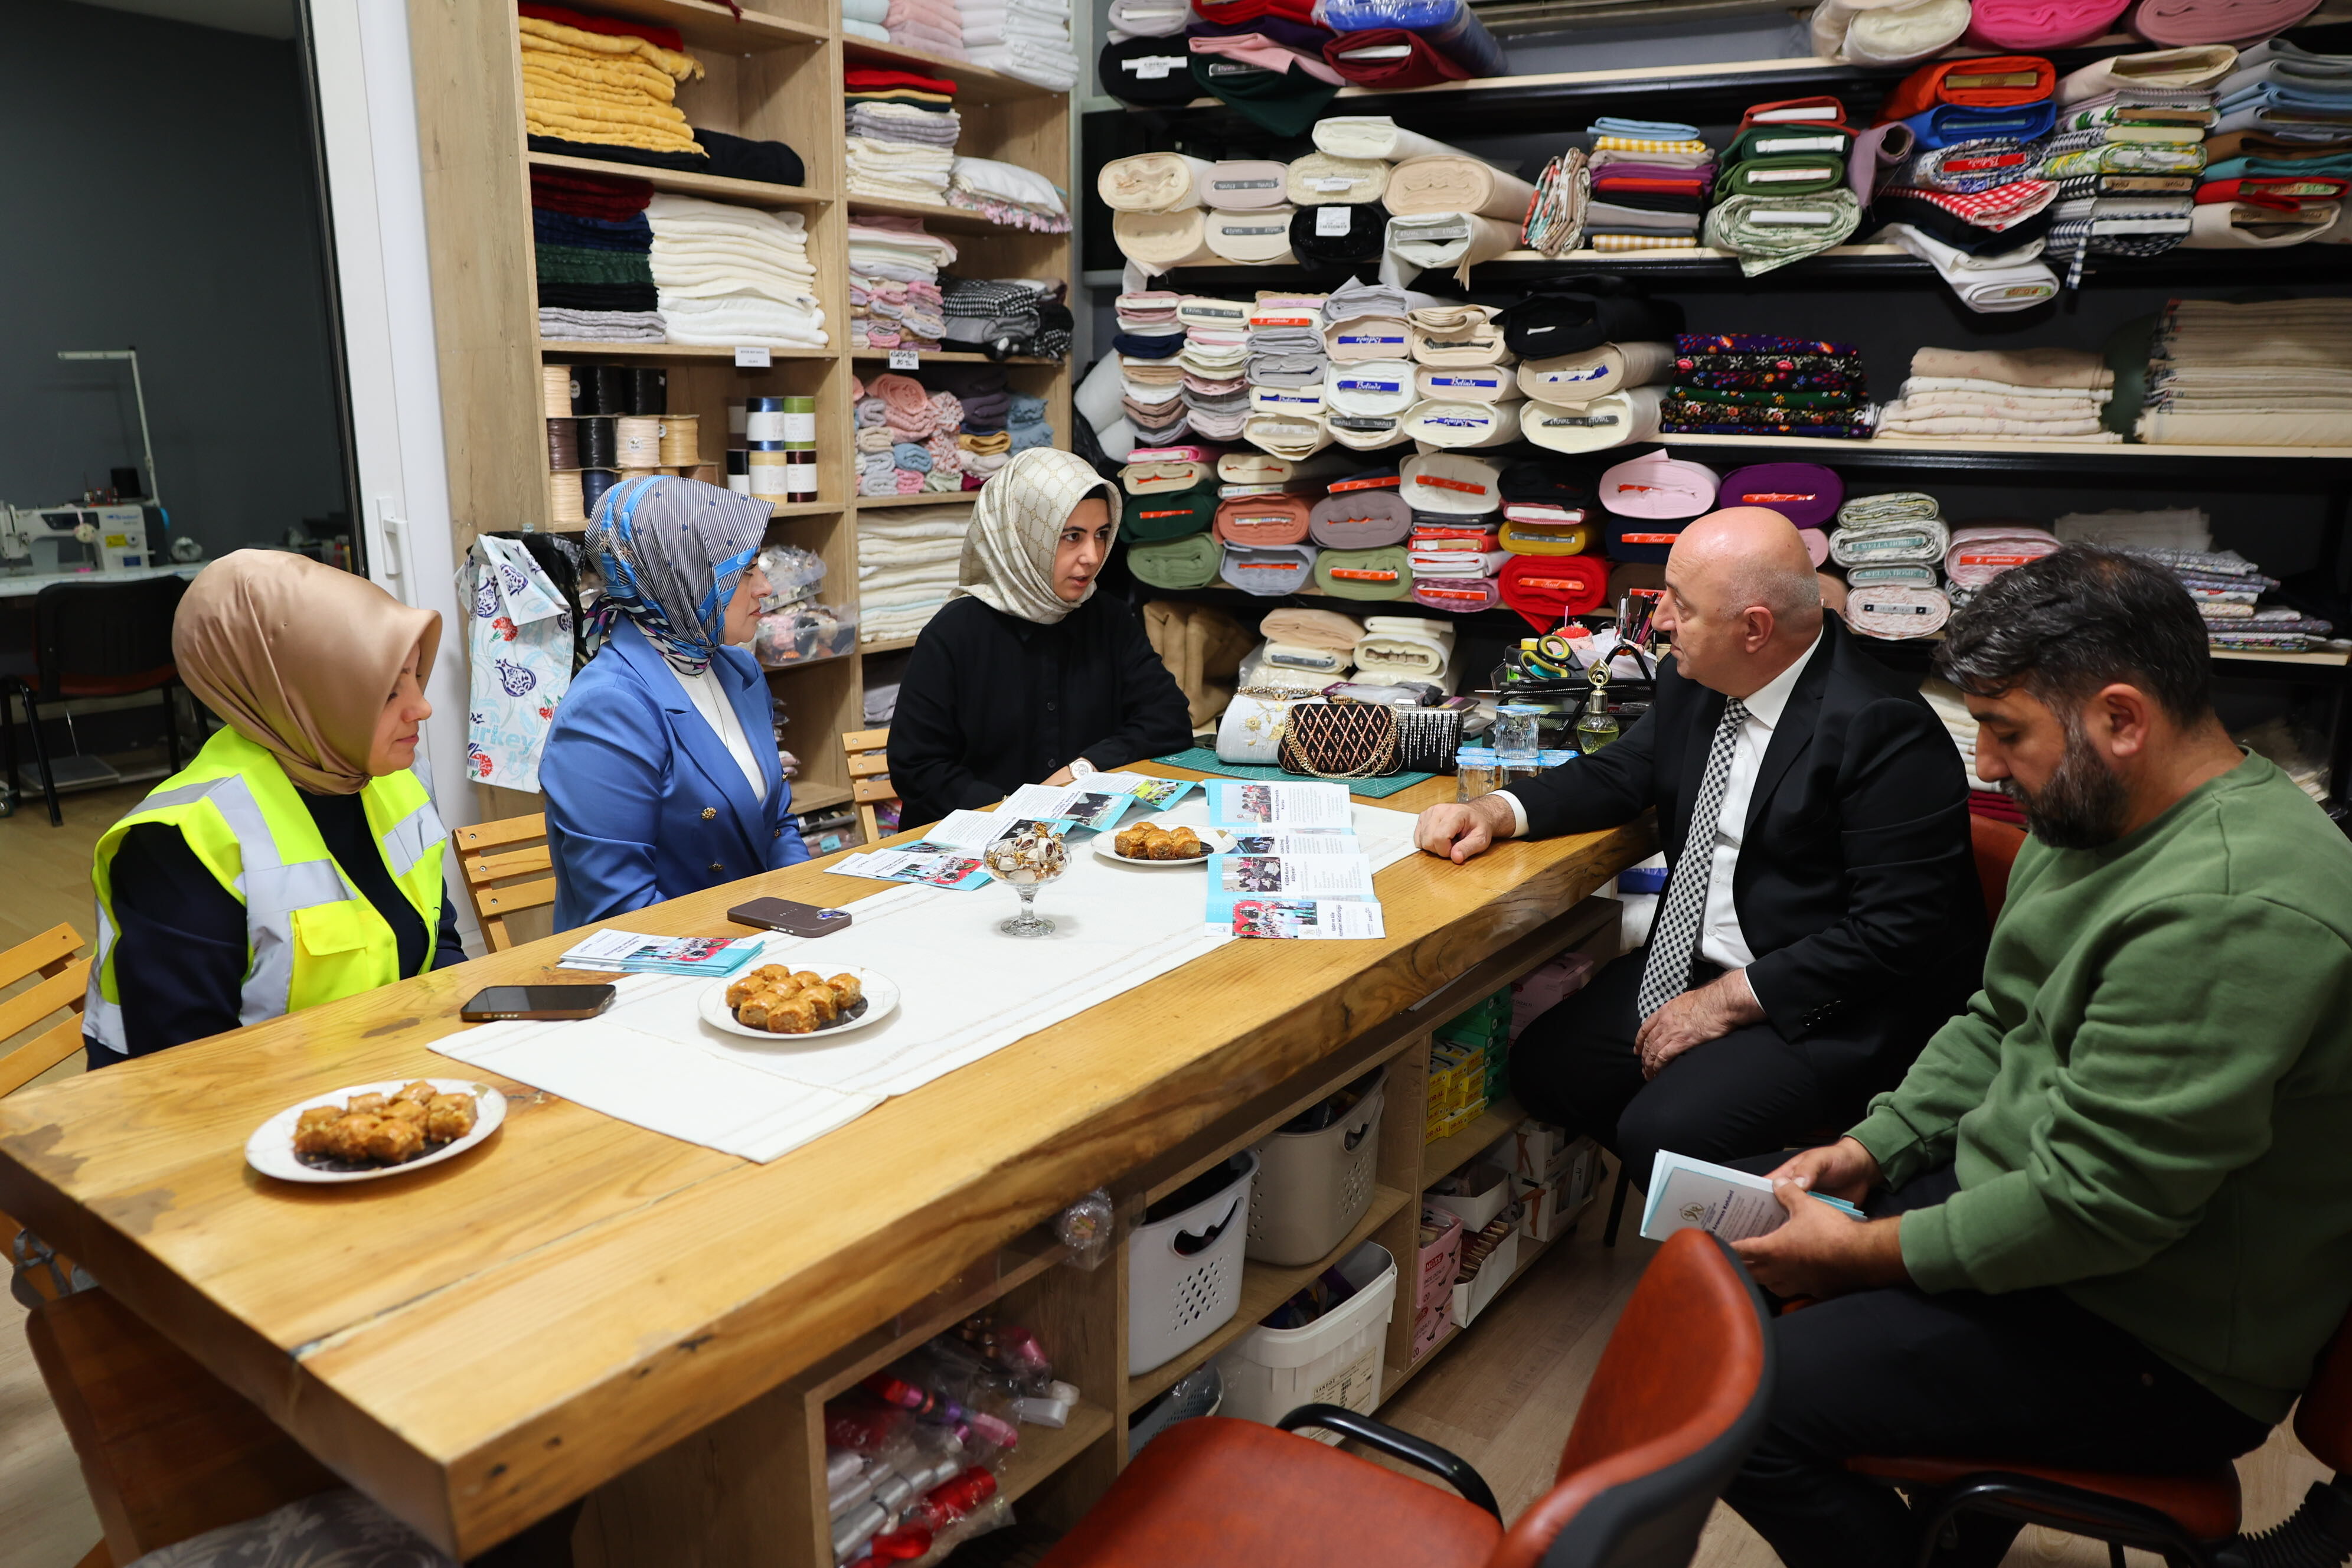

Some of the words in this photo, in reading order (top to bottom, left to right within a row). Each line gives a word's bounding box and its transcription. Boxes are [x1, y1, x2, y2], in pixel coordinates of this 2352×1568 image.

[1429, 1091, 1443, 1103] OR-AL
[1450, 1118, 1463, 1129] OR-AL
[1426, 1125, 1442, 1139] OR-AL
[1413, 1347, 1419, 1358] 20
